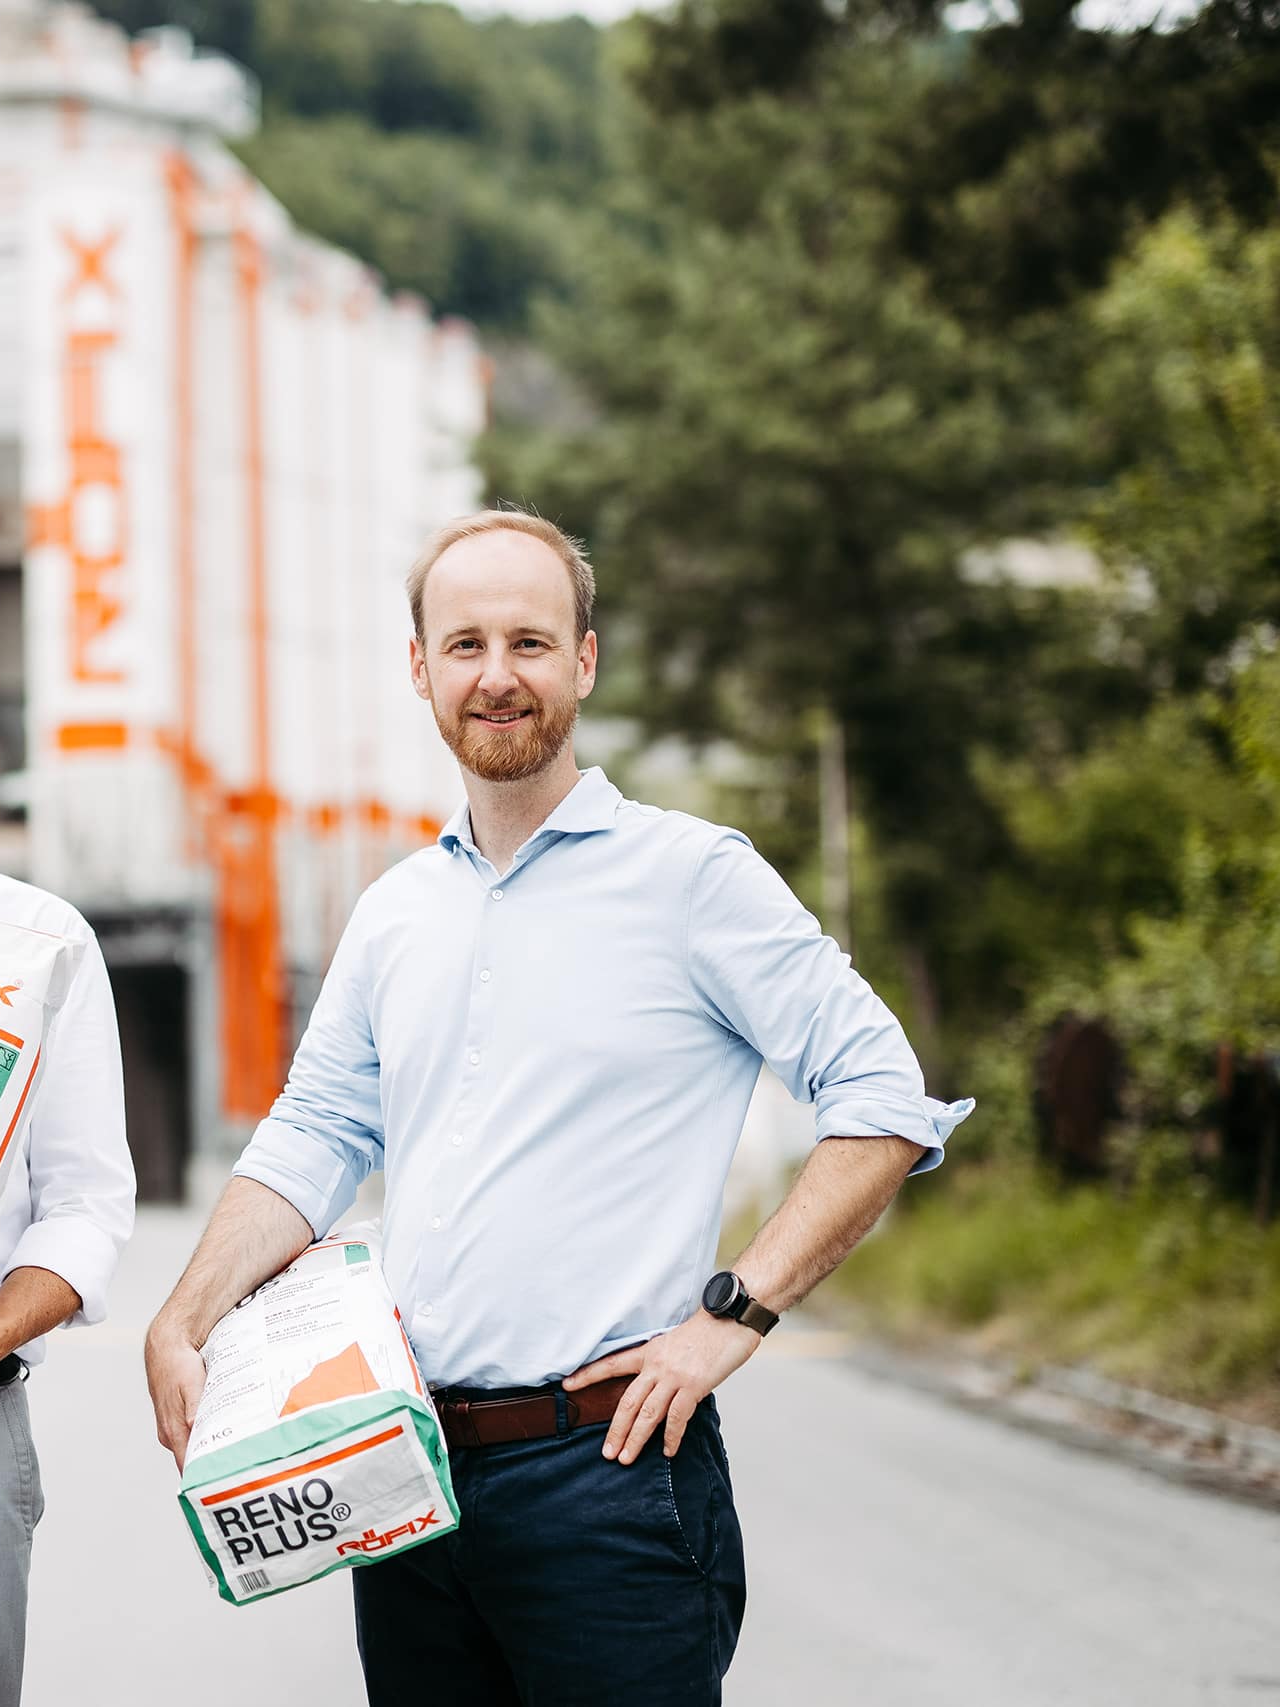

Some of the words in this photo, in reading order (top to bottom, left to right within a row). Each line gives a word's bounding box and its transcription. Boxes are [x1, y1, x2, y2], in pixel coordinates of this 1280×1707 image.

[211, 1427, 233, 1442] KG
[213, 1477, 334, 1538] RENO
[335, 1509, 441, 1557] RÖFIX
